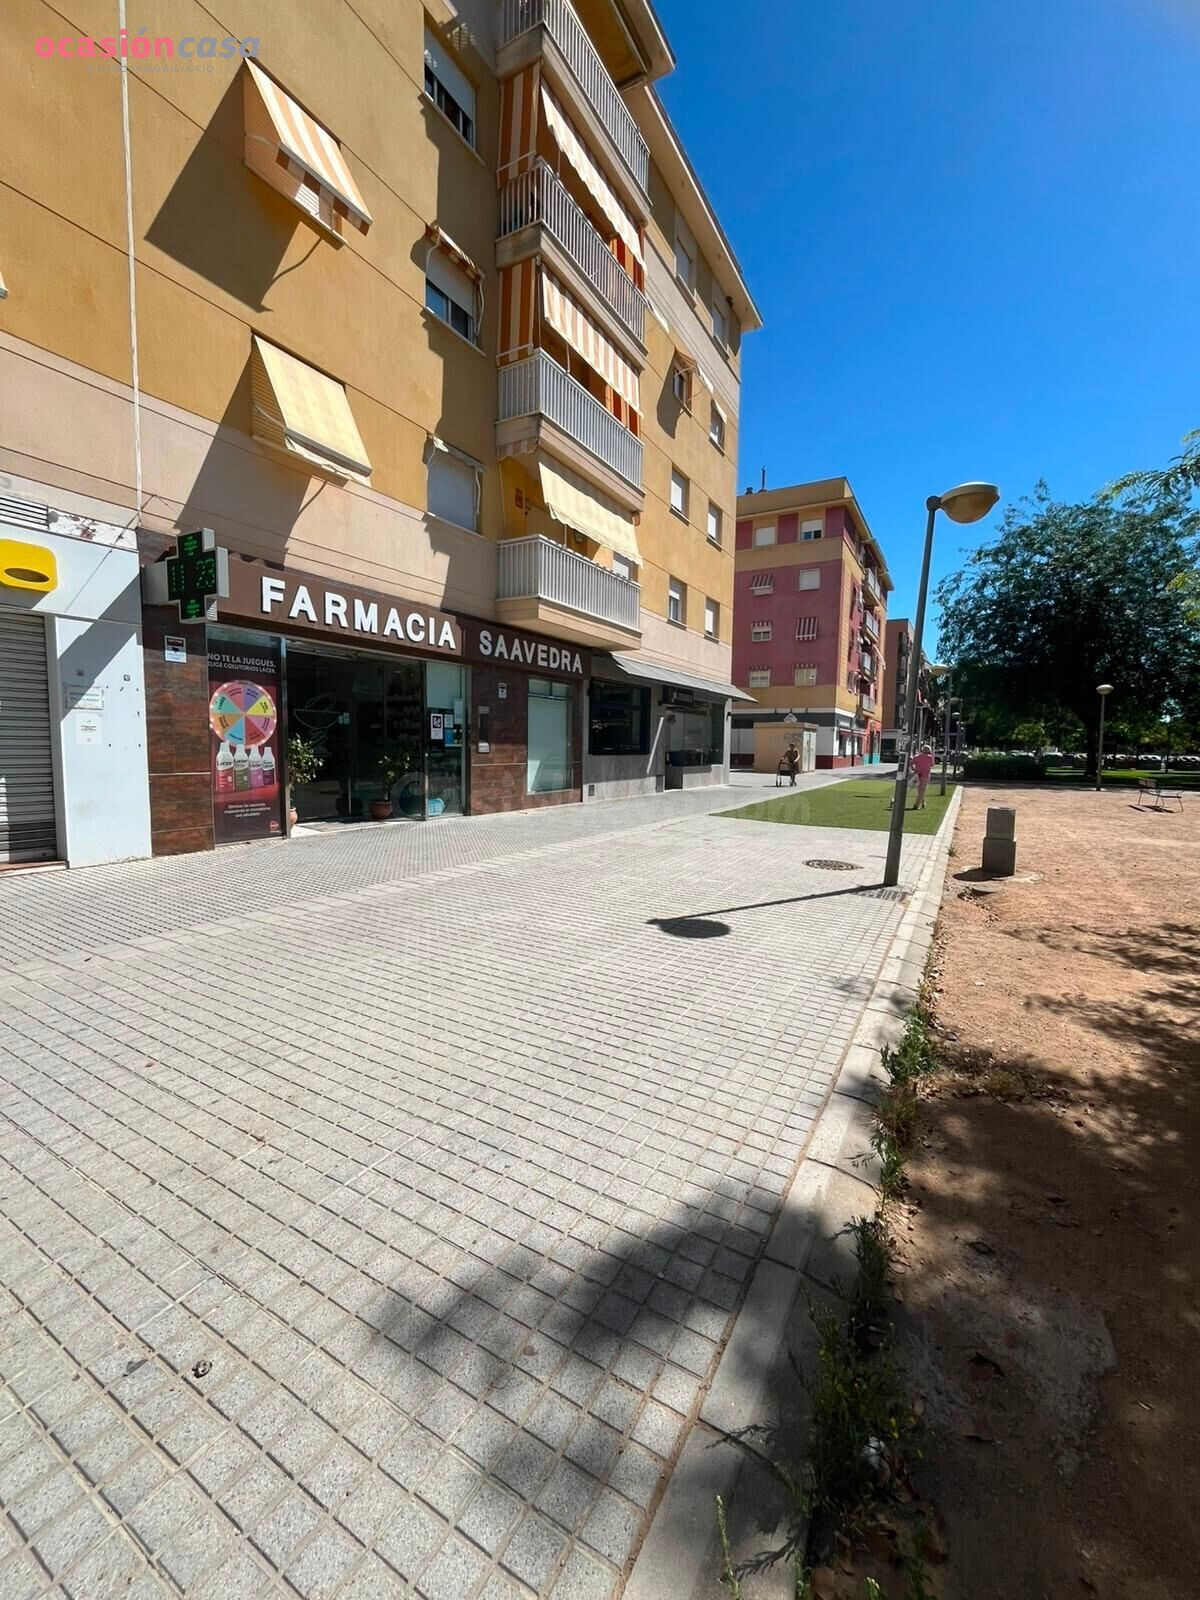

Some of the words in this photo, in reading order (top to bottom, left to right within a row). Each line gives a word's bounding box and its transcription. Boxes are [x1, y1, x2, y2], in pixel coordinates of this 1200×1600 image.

[261, 576, 457, 650] FARMACIA
[479, 630, 583, 674] SAAVEDRA
[207, 653, 221, 661] NO
[221, 654, 231, 663] TE
[231, 655, 242, 664] LA
[242, 656, 277, 668] JUEGUES.
